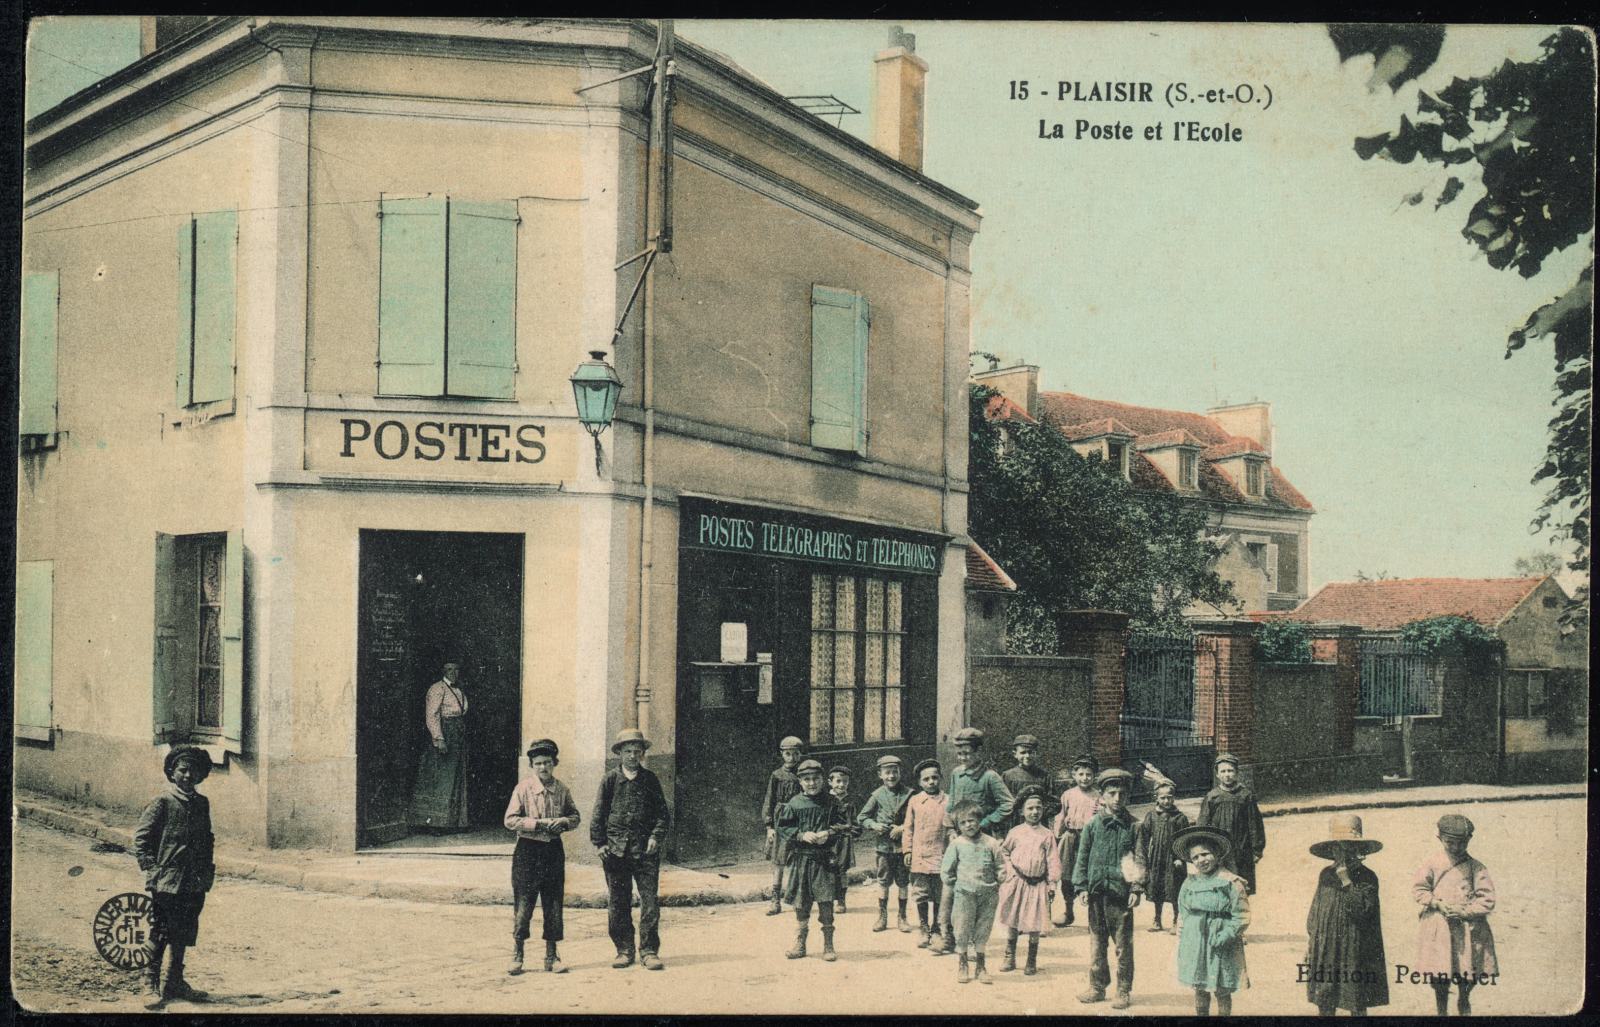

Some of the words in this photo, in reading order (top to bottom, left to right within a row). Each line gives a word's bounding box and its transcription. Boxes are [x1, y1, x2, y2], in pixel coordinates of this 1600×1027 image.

[339, 418, 547, 464] POSTES
[699, 513, 754, 550] POSTES
[856, 539, 869, 563] ET
